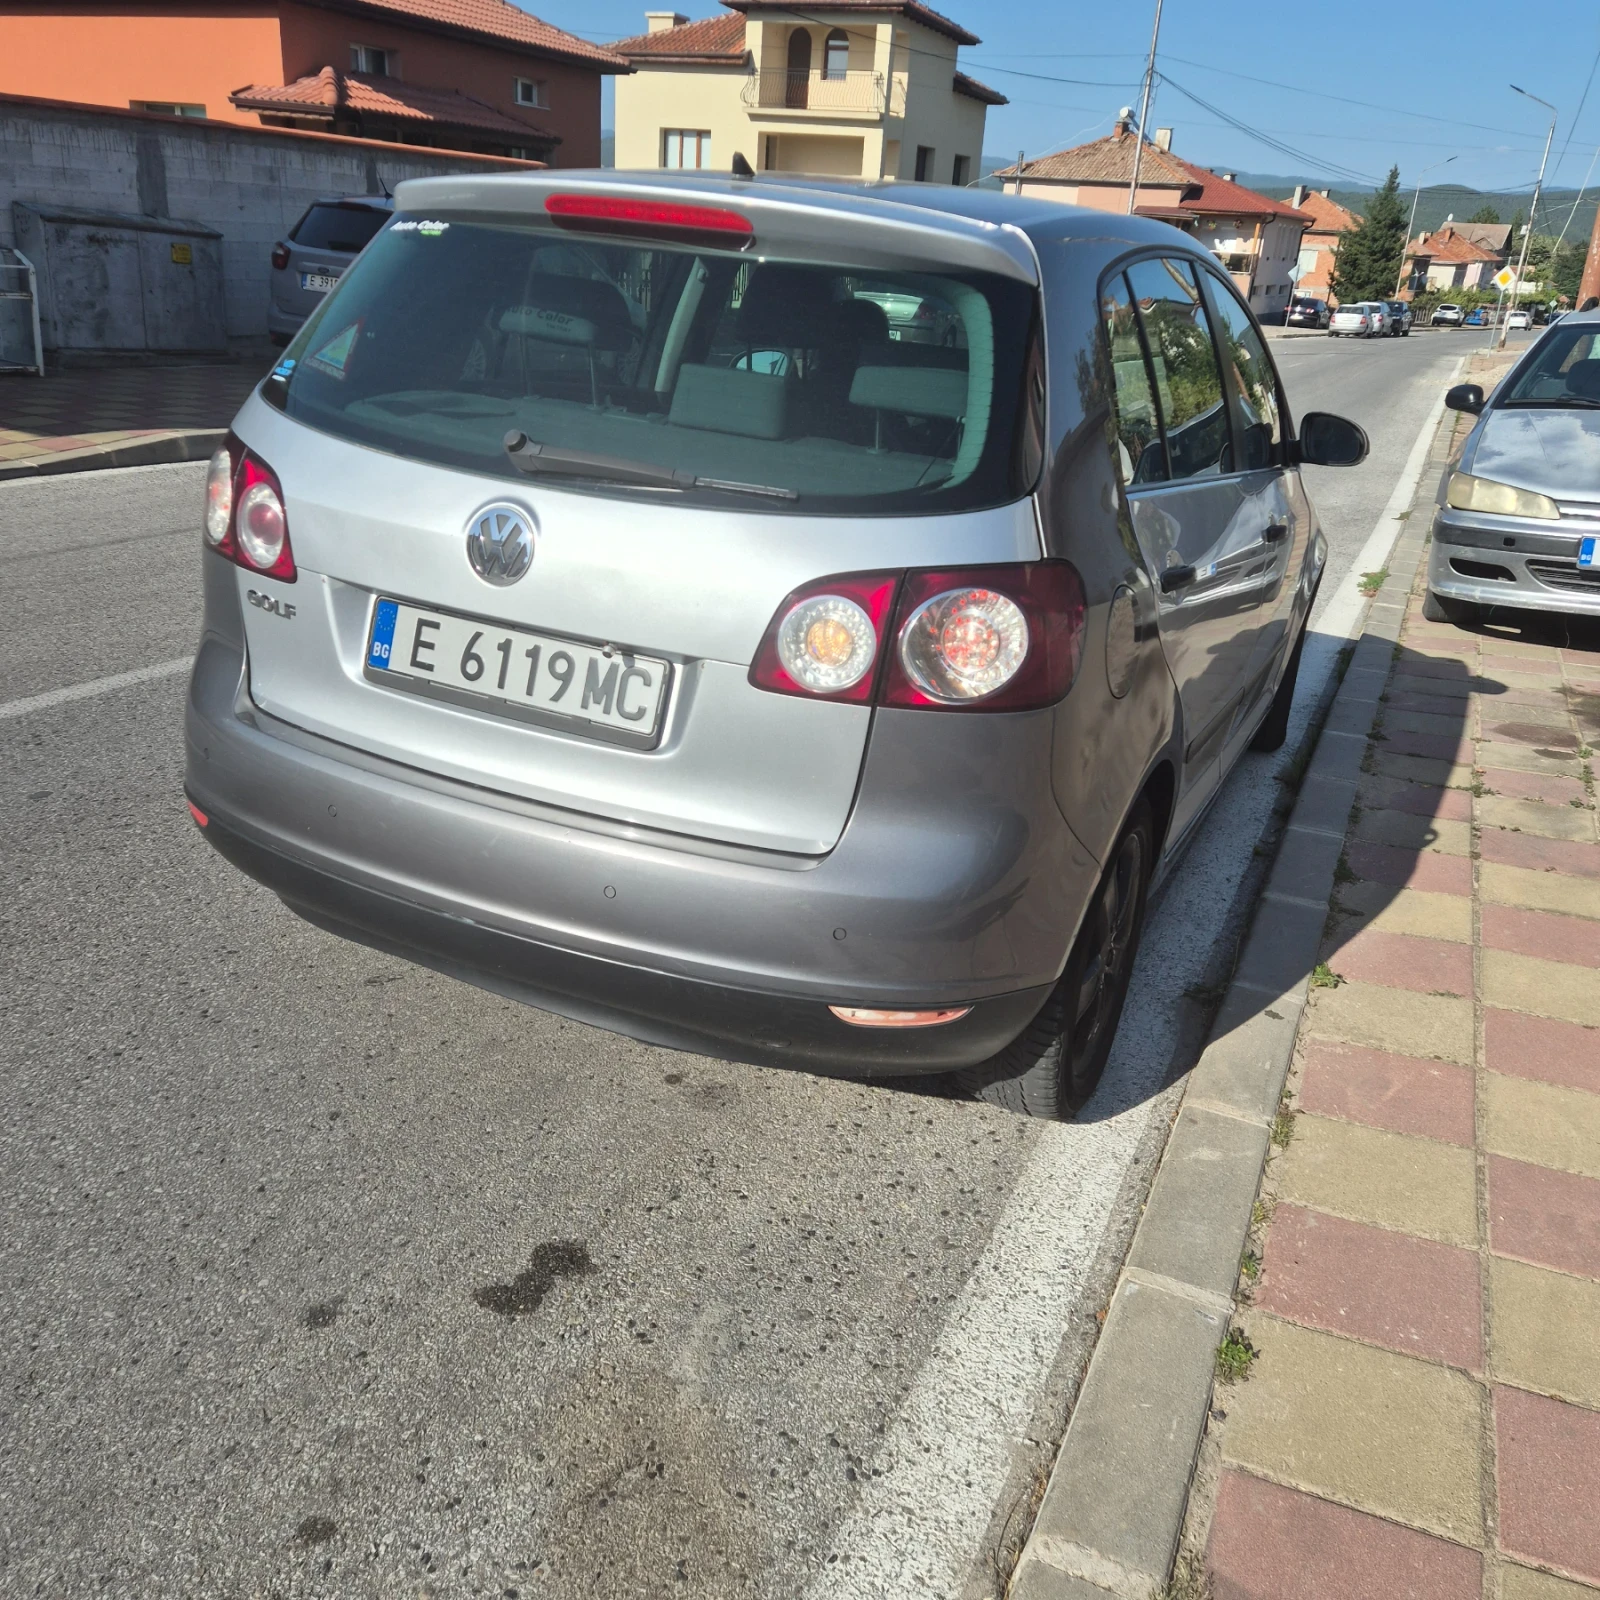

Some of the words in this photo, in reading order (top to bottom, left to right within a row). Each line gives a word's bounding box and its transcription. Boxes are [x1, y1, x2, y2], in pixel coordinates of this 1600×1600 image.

[310, 275, 317, 286] E
[247, 589, 296, 620] GOLF
[372, 641, 390, 659] BG
[410, 617, 441, 672] E
